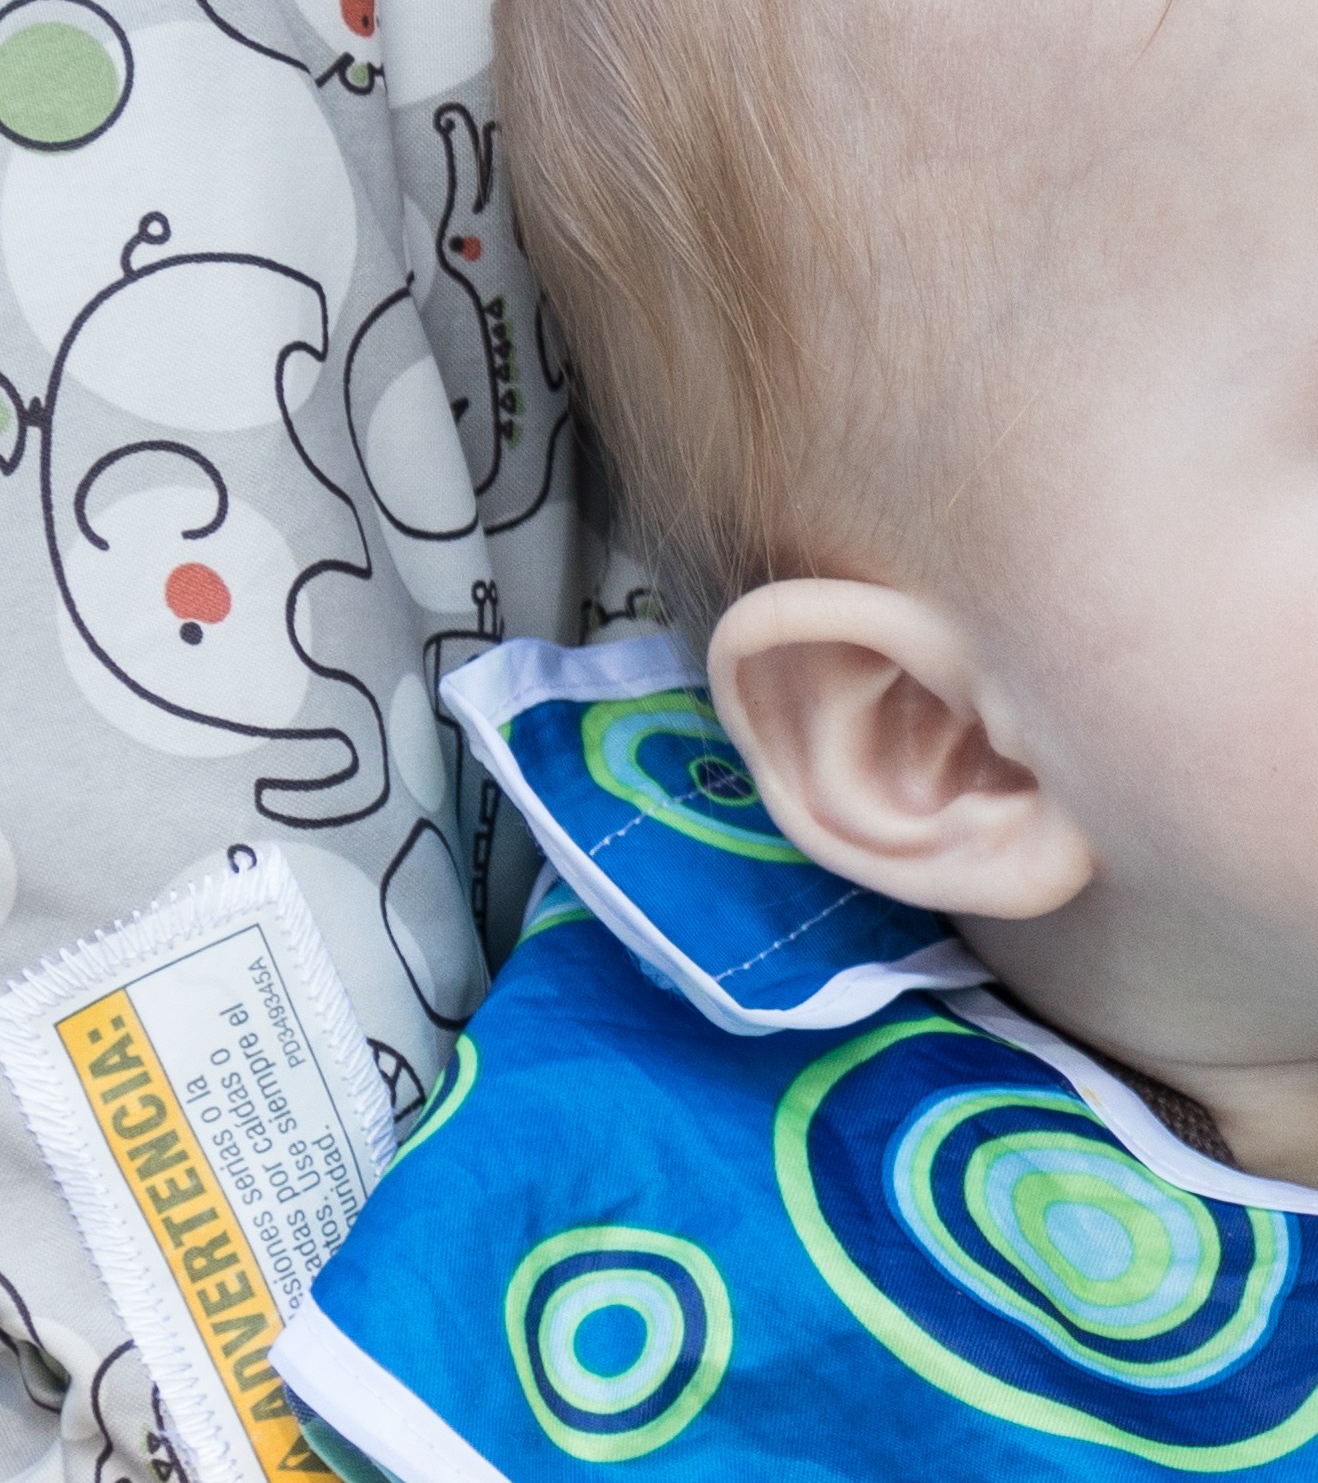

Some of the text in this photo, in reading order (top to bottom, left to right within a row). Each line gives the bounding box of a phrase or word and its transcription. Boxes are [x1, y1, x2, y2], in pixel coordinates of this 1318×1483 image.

[219, 1003, 249, 1026] el
[247, 957, 306, 1068] PD349345A
[187, 1074, 211, 1103] la
[201, 1107, 221, 1124] o
[238, 1033, 297, 1135] siempre
[211, 1048, 322, 1280] adas por caídas o
[213, 1129, 262, 1205] serias
[288, 1140, 320, 1193] Use
[87, 1015, 294, 1425] ADVERTENCIA:
